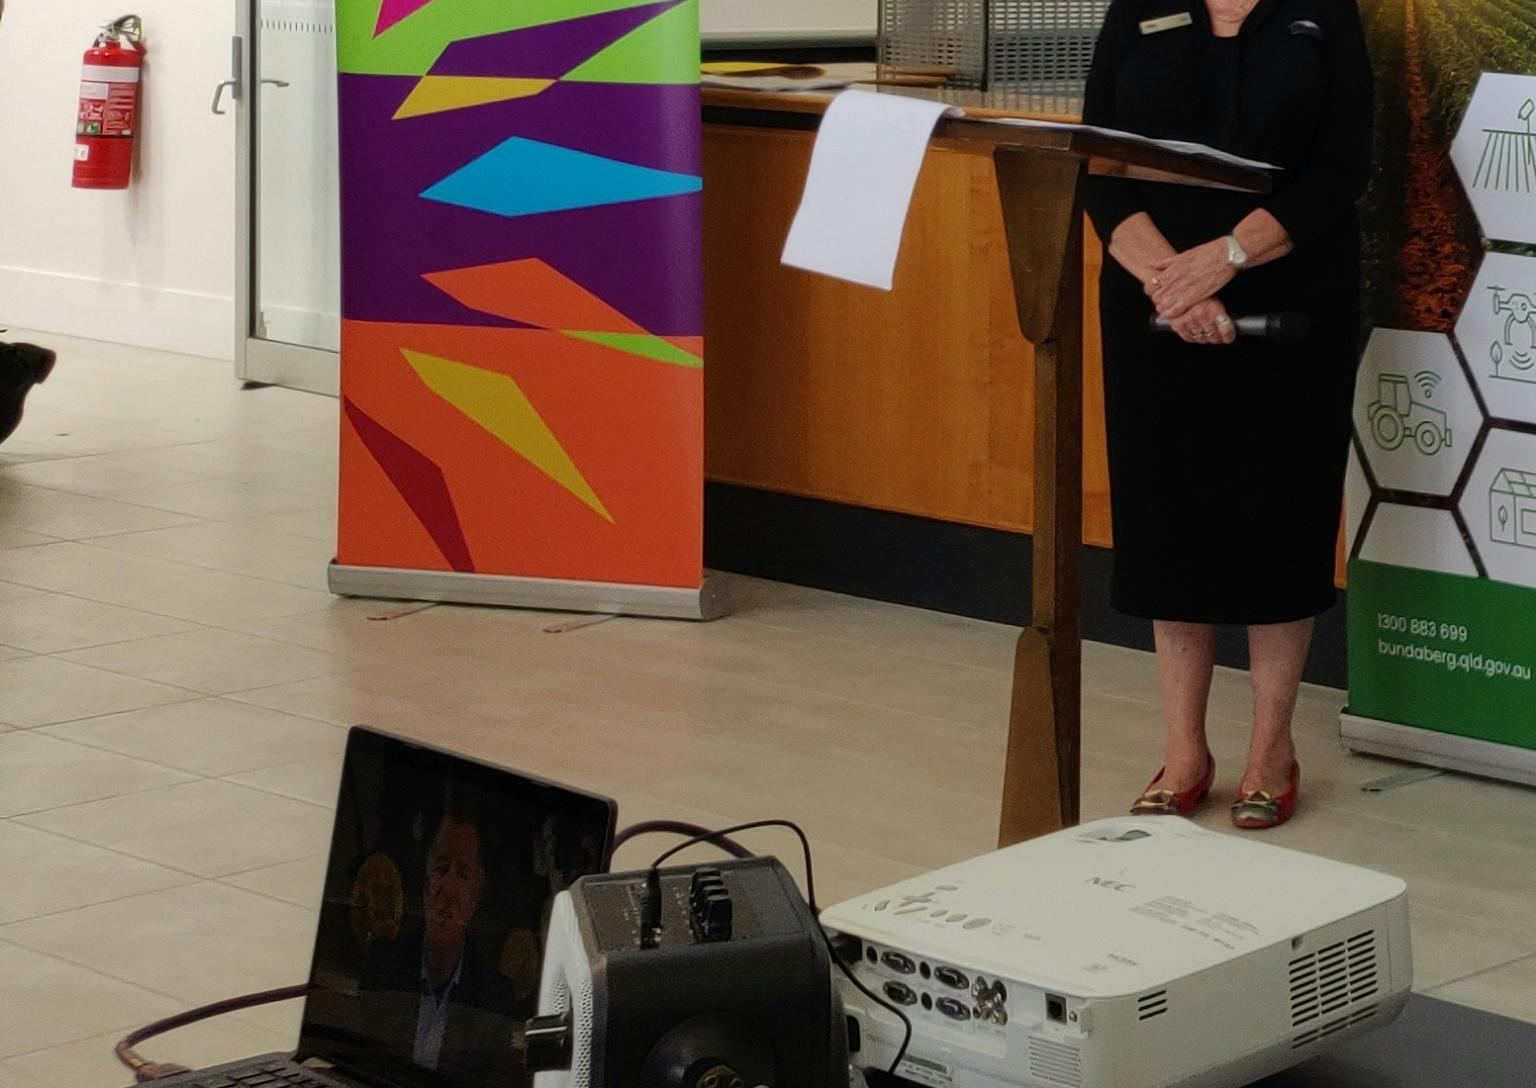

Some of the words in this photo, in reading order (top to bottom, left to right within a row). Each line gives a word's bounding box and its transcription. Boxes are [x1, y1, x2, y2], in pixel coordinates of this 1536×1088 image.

[1377, 613, 1406, 632] 1300
[1410, 618, 1437, 637] 883
[1440, 623, 1467, 642] 699
[1378, 638, 1531, 680] bundaberg.qld.gov.au
